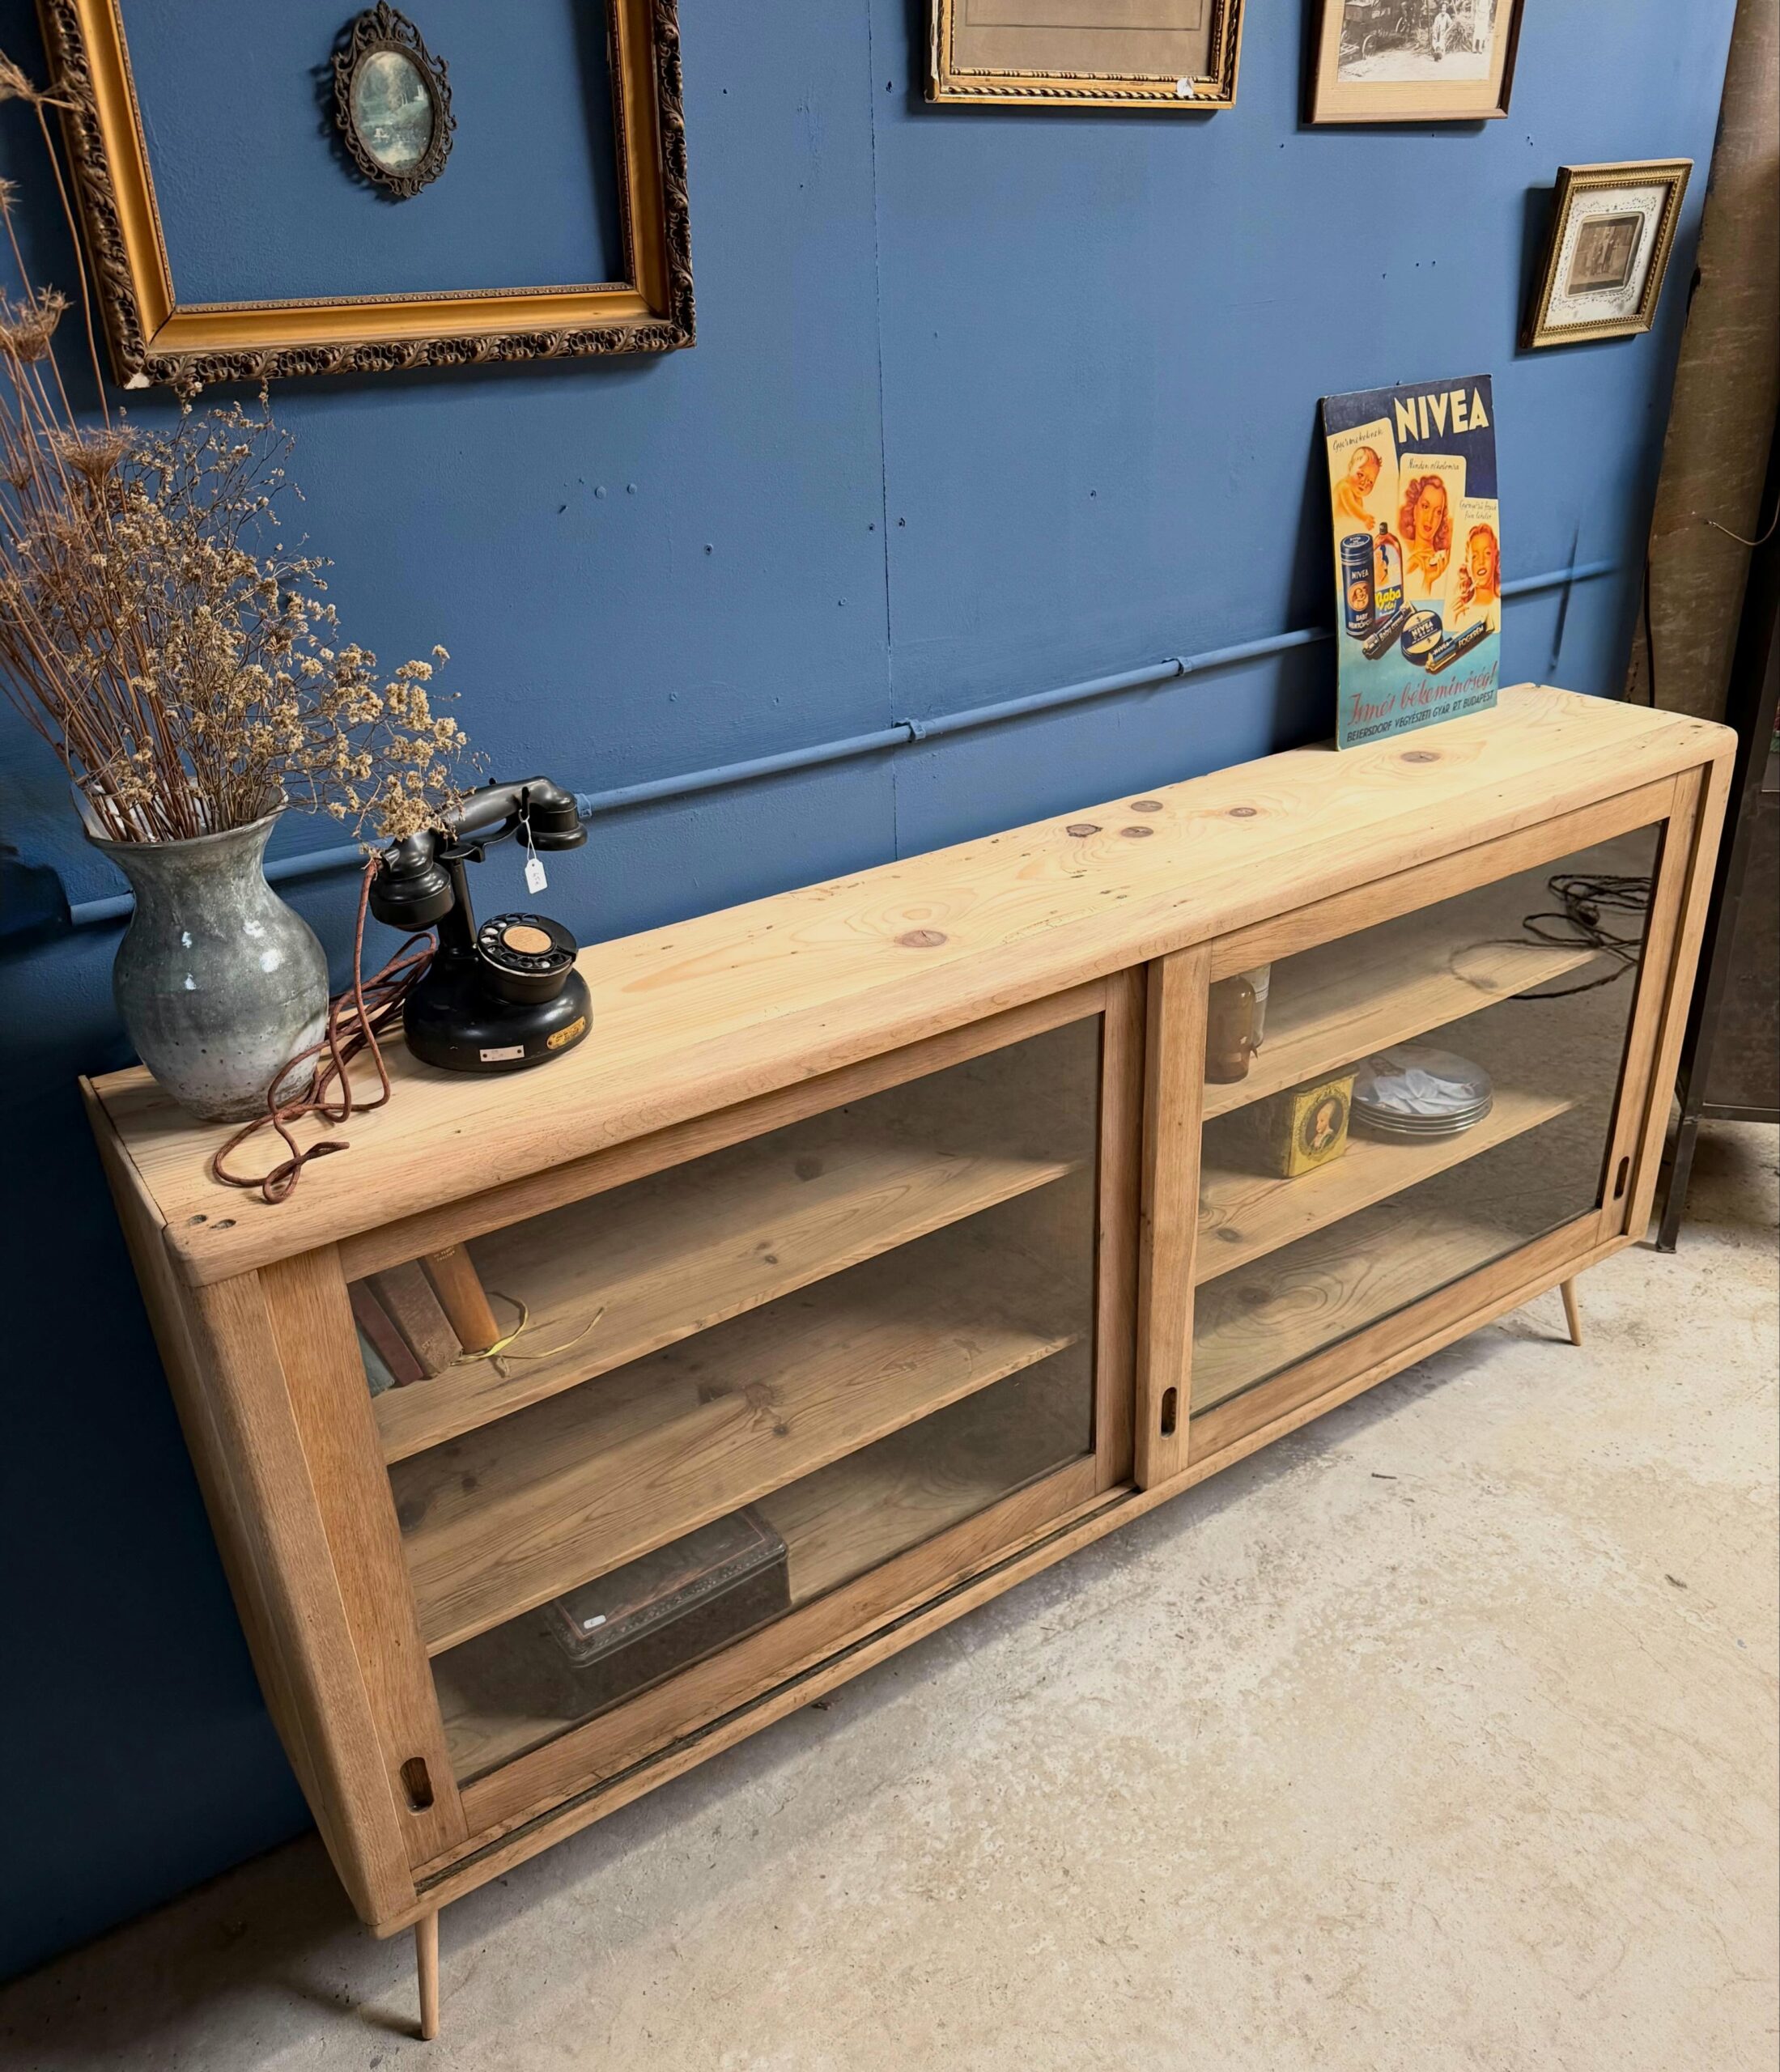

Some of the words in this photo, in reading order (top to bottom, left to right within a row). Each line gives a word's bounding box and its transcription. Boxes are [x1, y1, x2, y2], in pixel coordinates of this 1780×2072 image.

[1394, 388, 1489, 444] NIVEA
[1351, 569, 1369, 580] NIVEA
[1376, 588, 1401, 609] Baba
[1356, 613, 1368, 622] BABY
[1412, 621, 1434, 638] NIVEA
[1346, 721, 1392, 743] BEIERSDORF
[1395, 709, 1431, 728] VEGYÉSZETI
[1433, 701, 1450, 717] GYÁR
[1463, 690, 1494, 708] BUDAPEST
